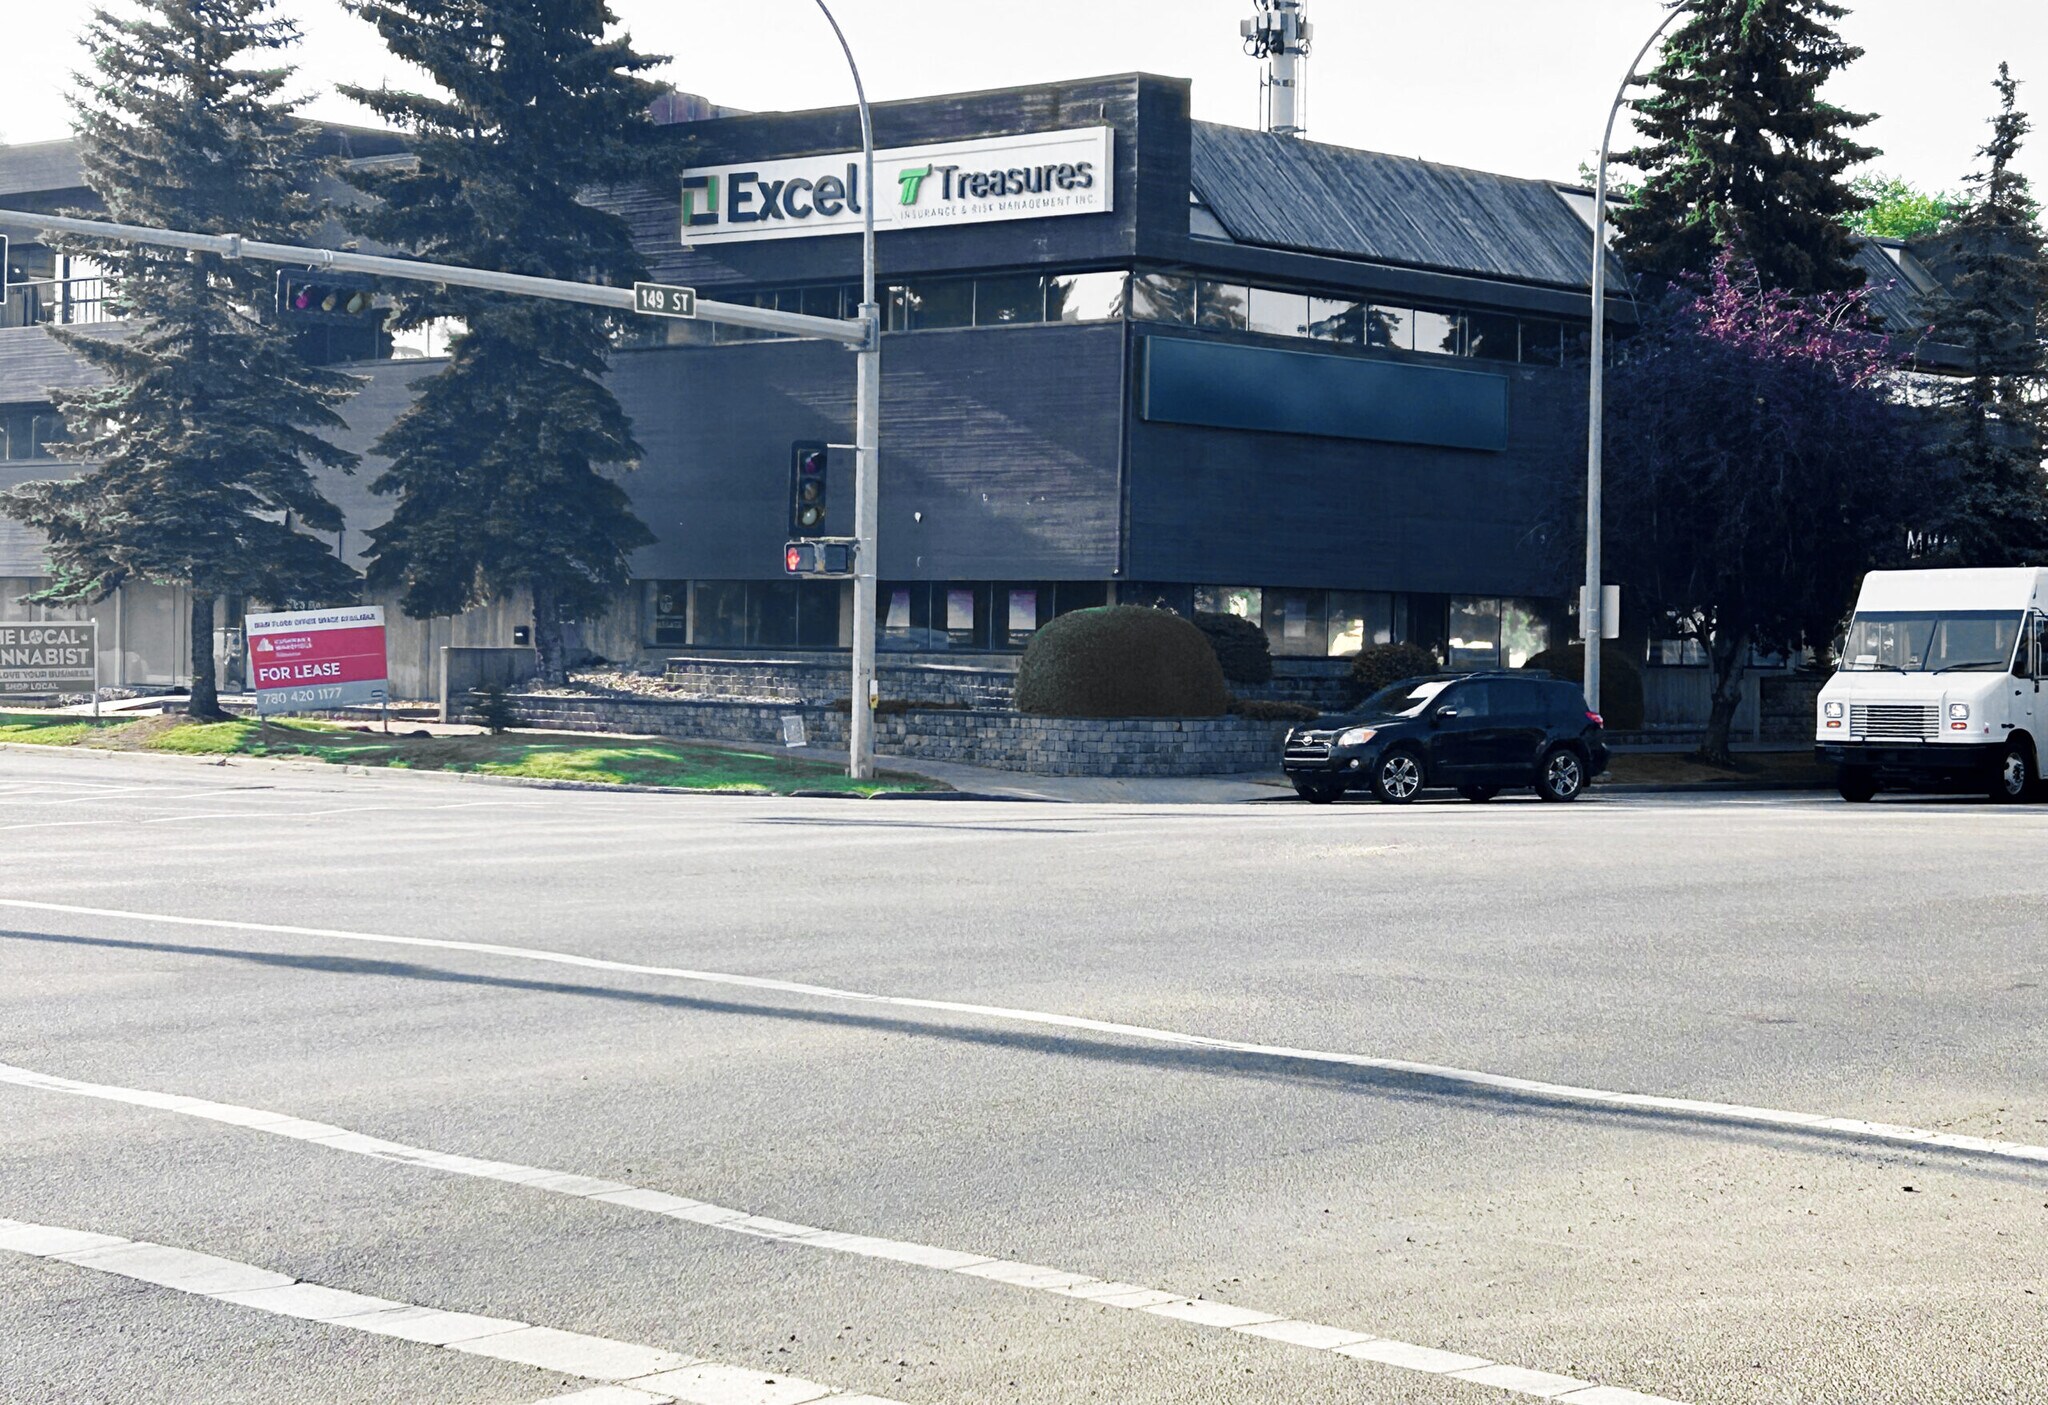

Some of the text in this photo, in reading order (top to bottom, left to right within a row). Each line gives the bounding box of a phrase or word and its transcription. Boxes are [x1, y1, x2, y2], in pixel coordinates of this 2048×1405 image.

[935, 162, 1093, 201] Treasures
[728, 163, 861, 223] Excel
[642, 289, 689, 311] 149 ST
[0, 629, 80, 645] E LOCAL
[0, 648, 89, 665] NNABIST
[259, 662, 341, 681] FOR LEASE
[31, 682, 59, 690] LOCAL
[263, 687, 342, 704] 780 420 1177
